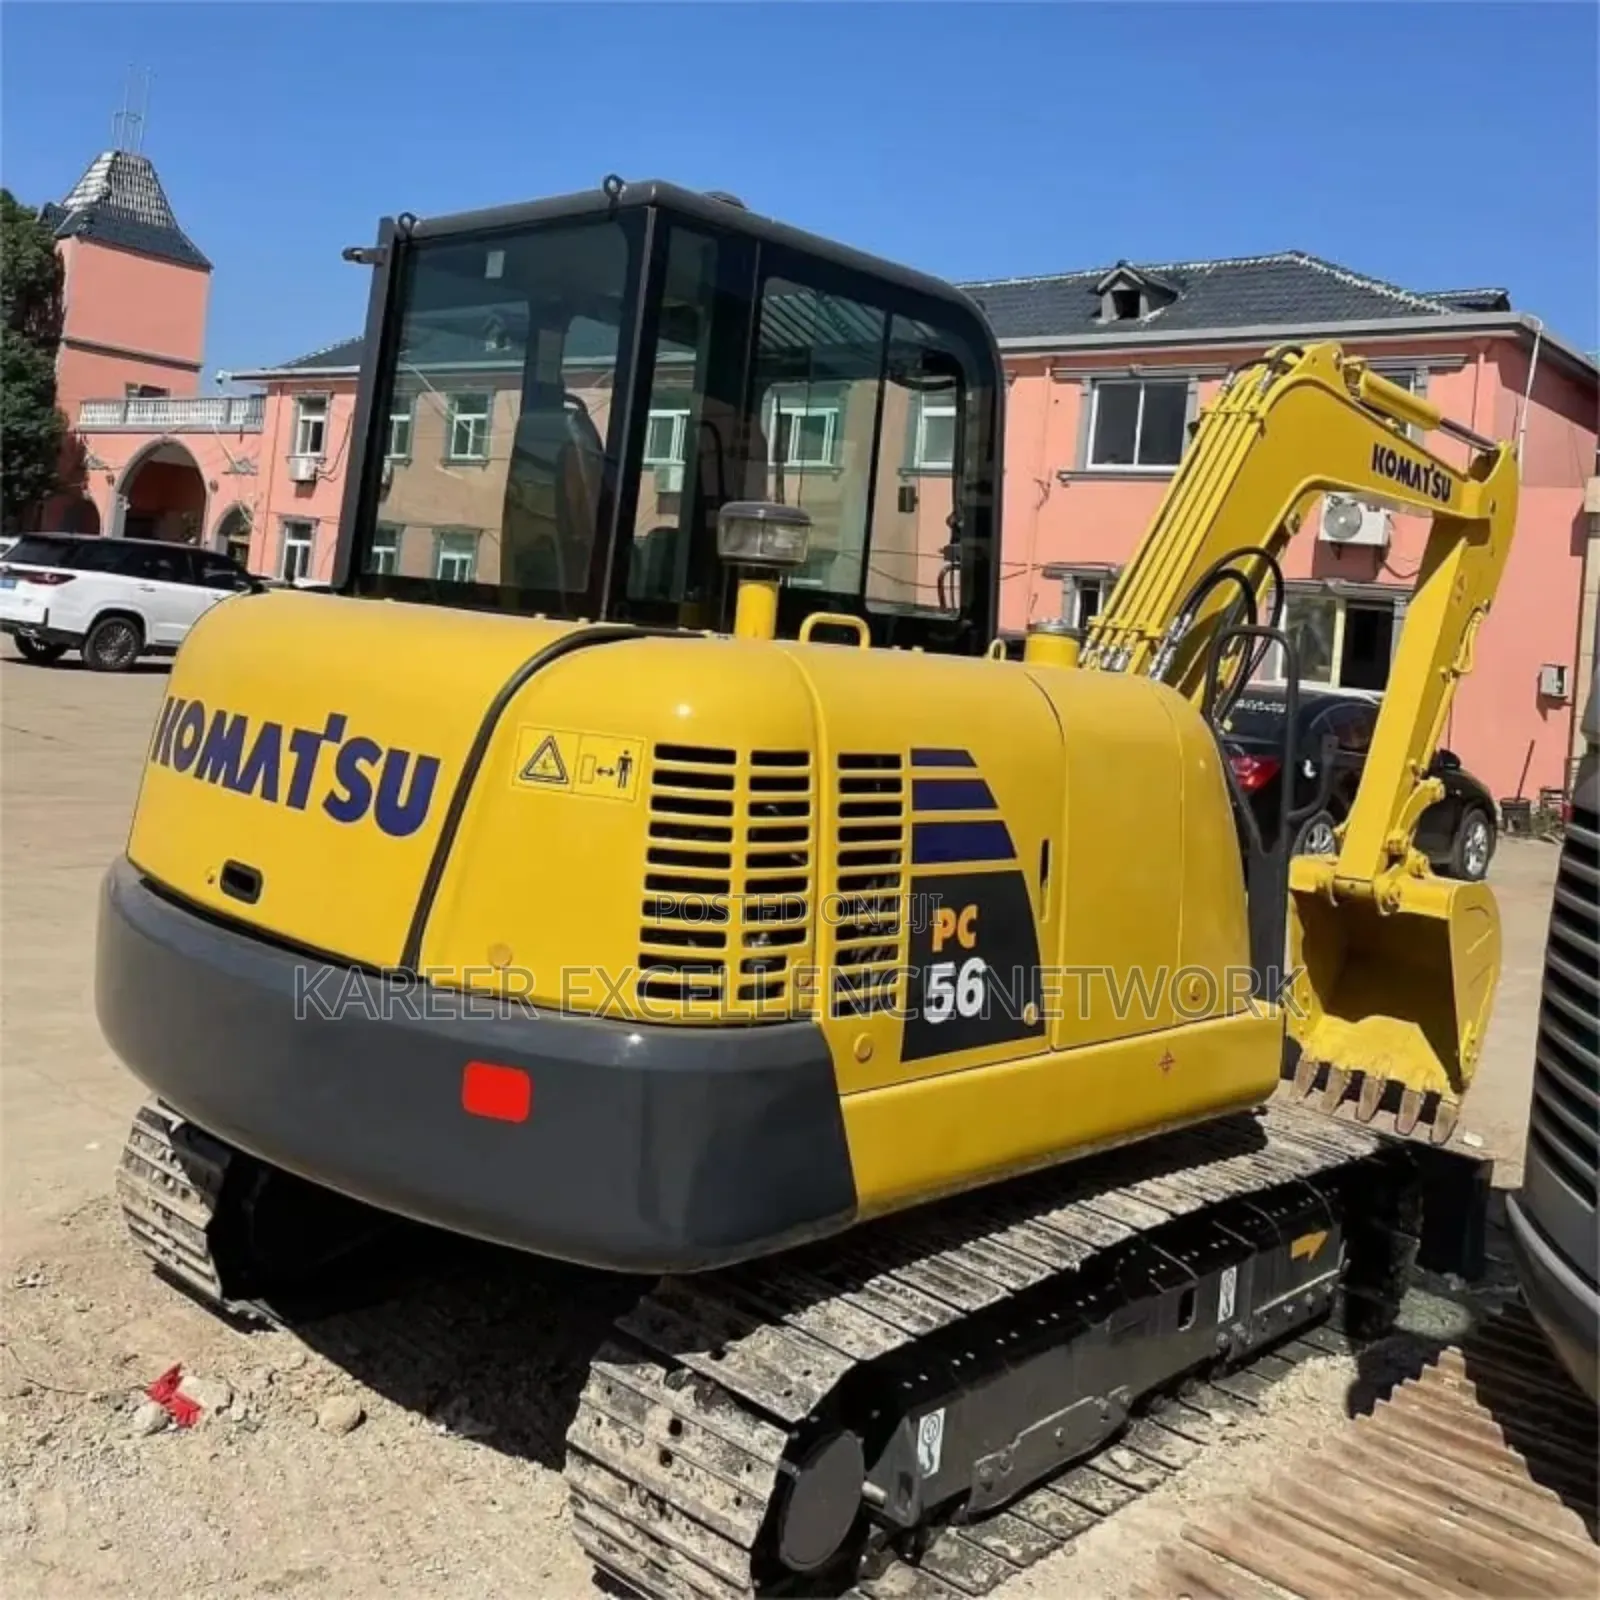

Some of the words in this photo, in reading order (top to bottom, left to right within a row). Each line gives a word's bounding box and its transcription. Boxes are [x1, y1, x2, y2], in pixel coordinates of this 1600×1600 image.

[1371, 442, 1452, 502] KOMATSU
[151, 695, 440, 837] KOMATSU
[932, 904, 979, 951] PC
[924, 957, 986, 1024] 56
